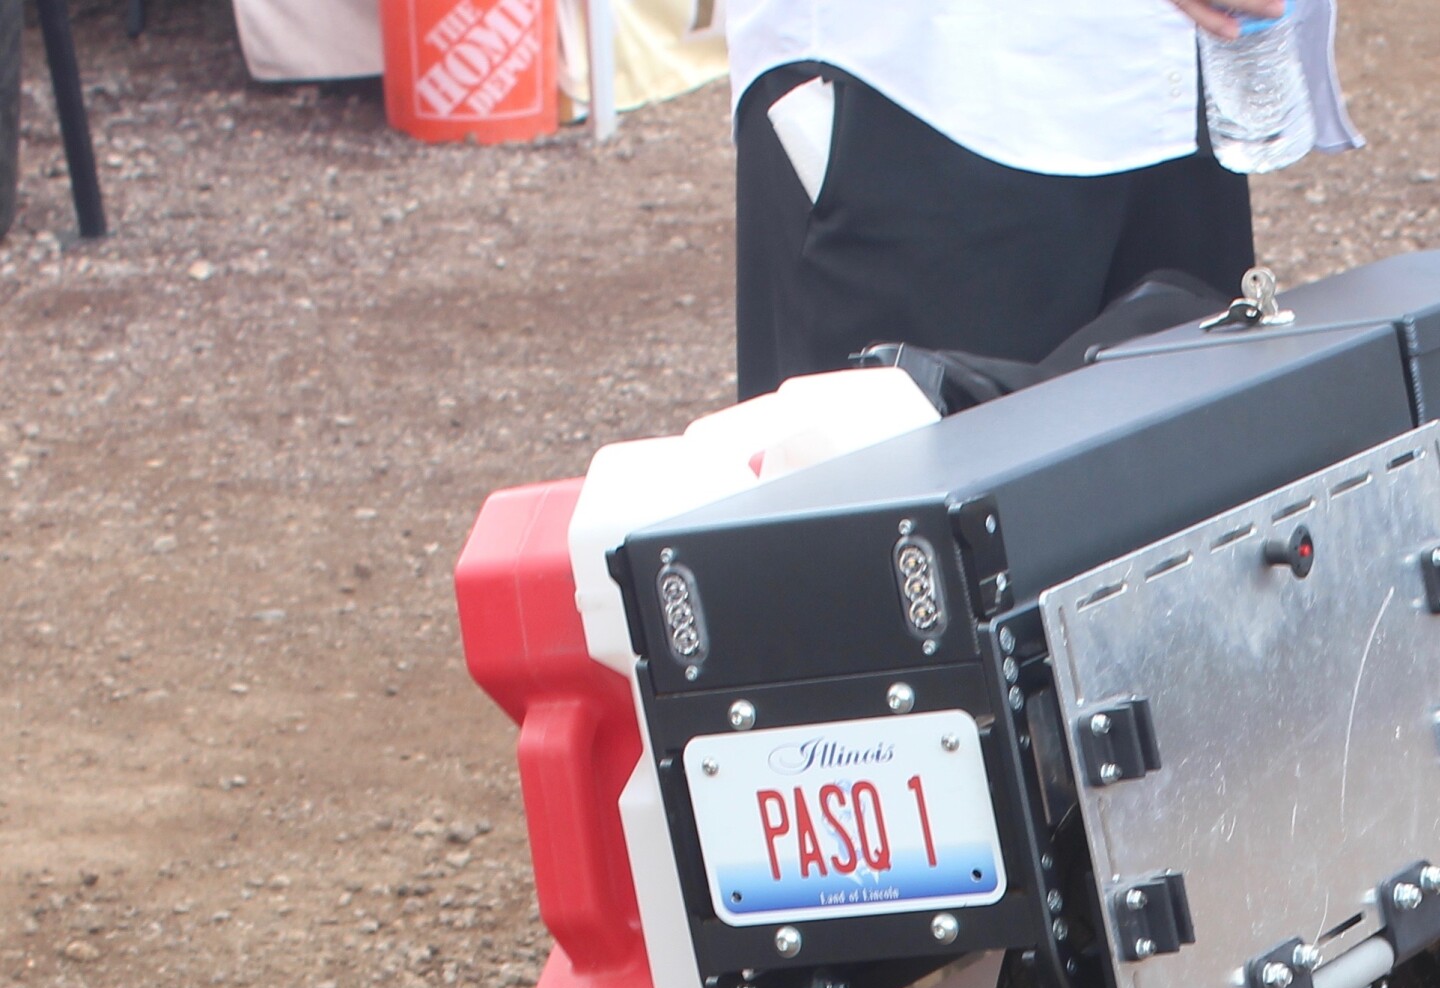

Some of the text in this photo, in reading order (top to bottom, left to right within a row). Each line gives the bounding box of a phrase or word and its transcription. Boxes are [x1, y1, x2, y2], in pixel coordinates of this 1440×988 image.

[414, 0, 541, 118] HOM
[422, 0, 484, 53] THE
[465, 33, 541, 118] DEPOT
[768, 737, 895, 775] Illinois
[757, 774, 937, 881] PASQ 1
[820, 885, 899, 905] Land of Lincoln
